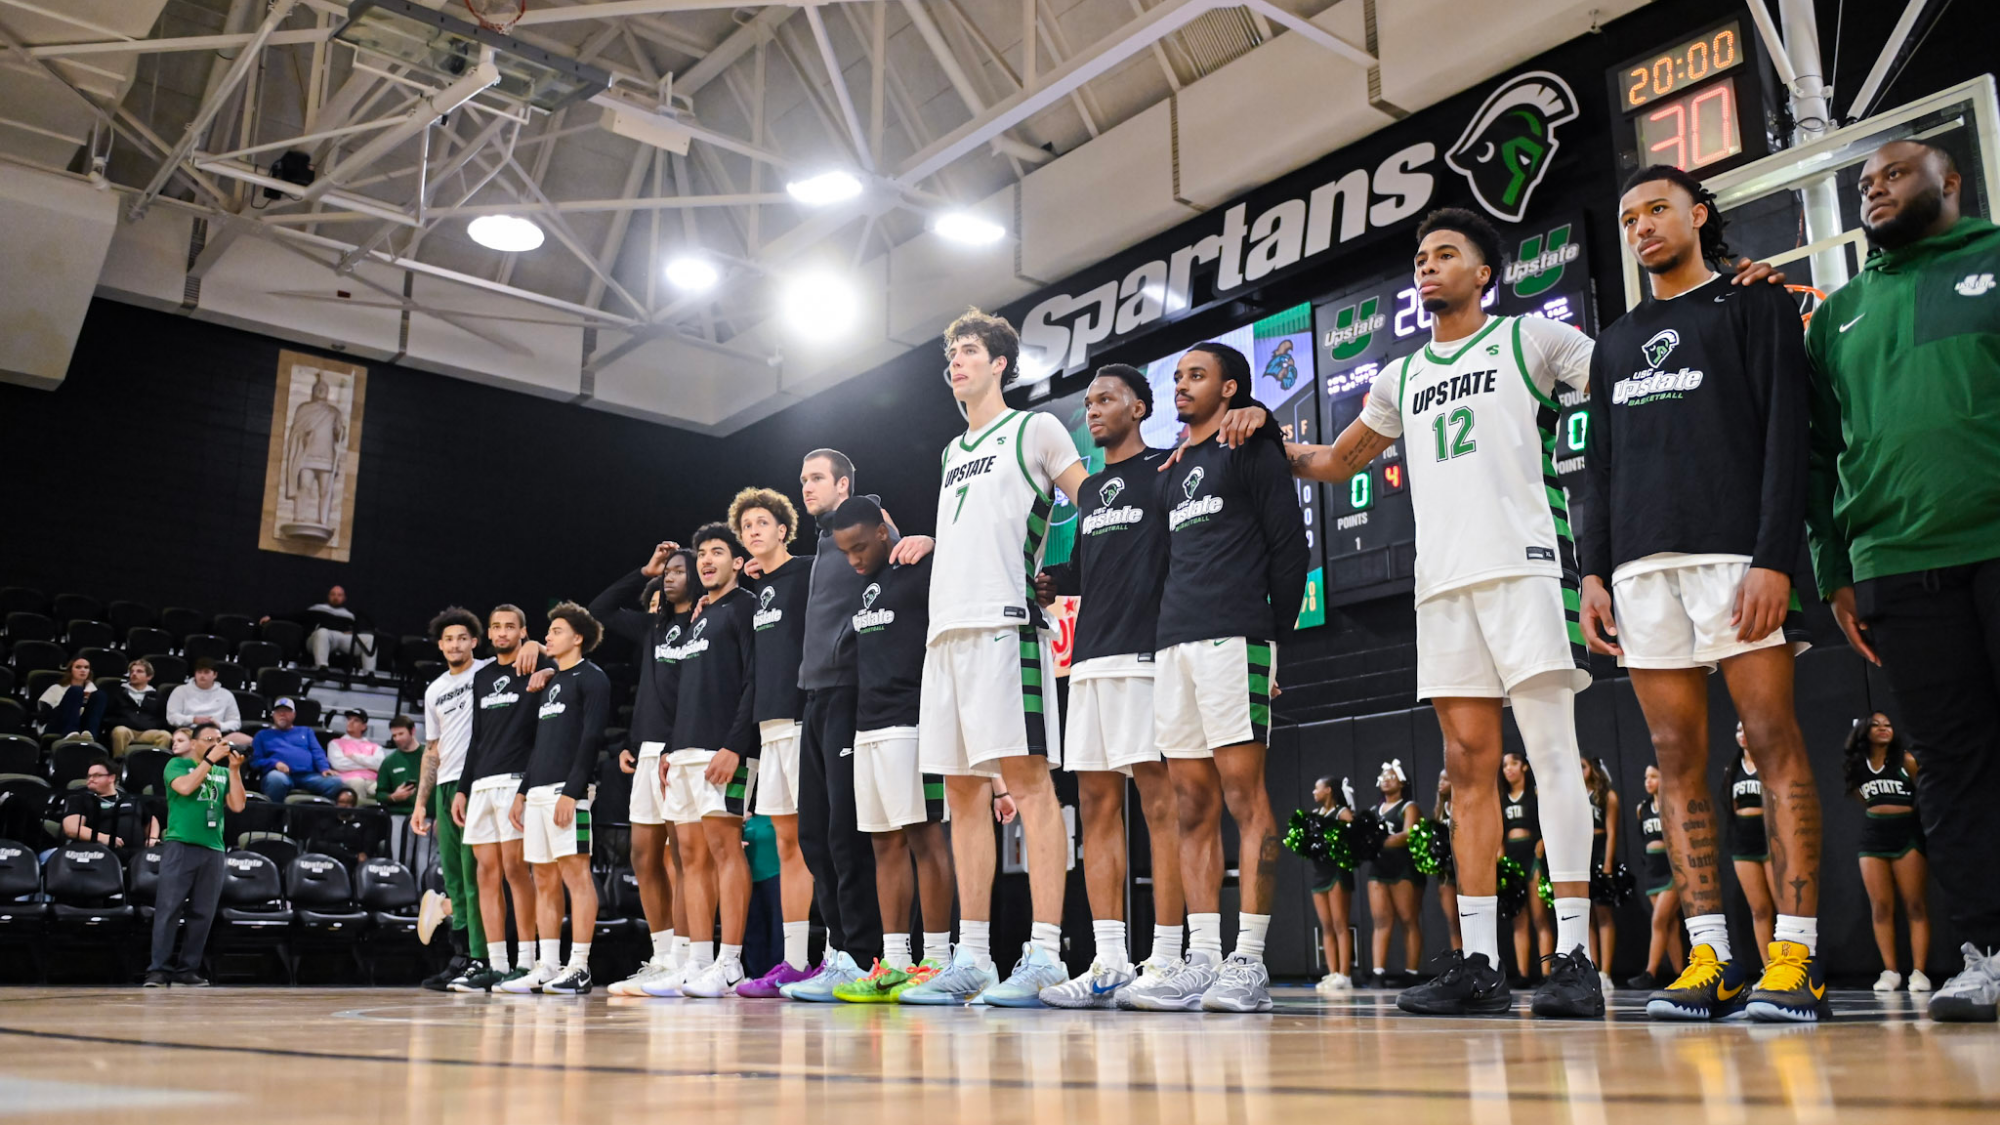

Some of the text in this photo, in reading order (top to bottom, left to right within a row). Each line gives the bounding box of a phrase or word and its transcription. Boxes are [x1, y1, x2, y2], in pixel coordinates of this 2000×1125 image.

[1629, 30, 1734, 105] 20:00
[1650, 86, 1731, 171] 30
[1014, 141, 1436, 384] Spartans
[1503, 243, 1580, 285] Upstate
[1322, 313, 1386, 350] Upstate
[1612, 368, 1703, 404] Upstate
[1633, 368, 1653, 379] USC
[1412, 369, 1497, 415] UPSTATE
[1628, 392, 1683, 406] BASKETBALL
[1433, 406, 1476, 462] 12
[1568, 411, 1588, 450] 0
[945, 455, 997, 488] UPSTATE
[1385, 465, 1400, 488] 4
[1557, 456, 1585, 474] OINT
[953, 483, 970, 525] 7
[1351, 471, 1371, 509] 0
[1082, 505, 1143, 535] Upstate
[1169, 495, 1224, 531] Upstate
[1338, 512, 1368, 530] POINTS
[1733, 780, 1761, 799] PSTAT
[1859, 779, 1905, 799] PSTATE
